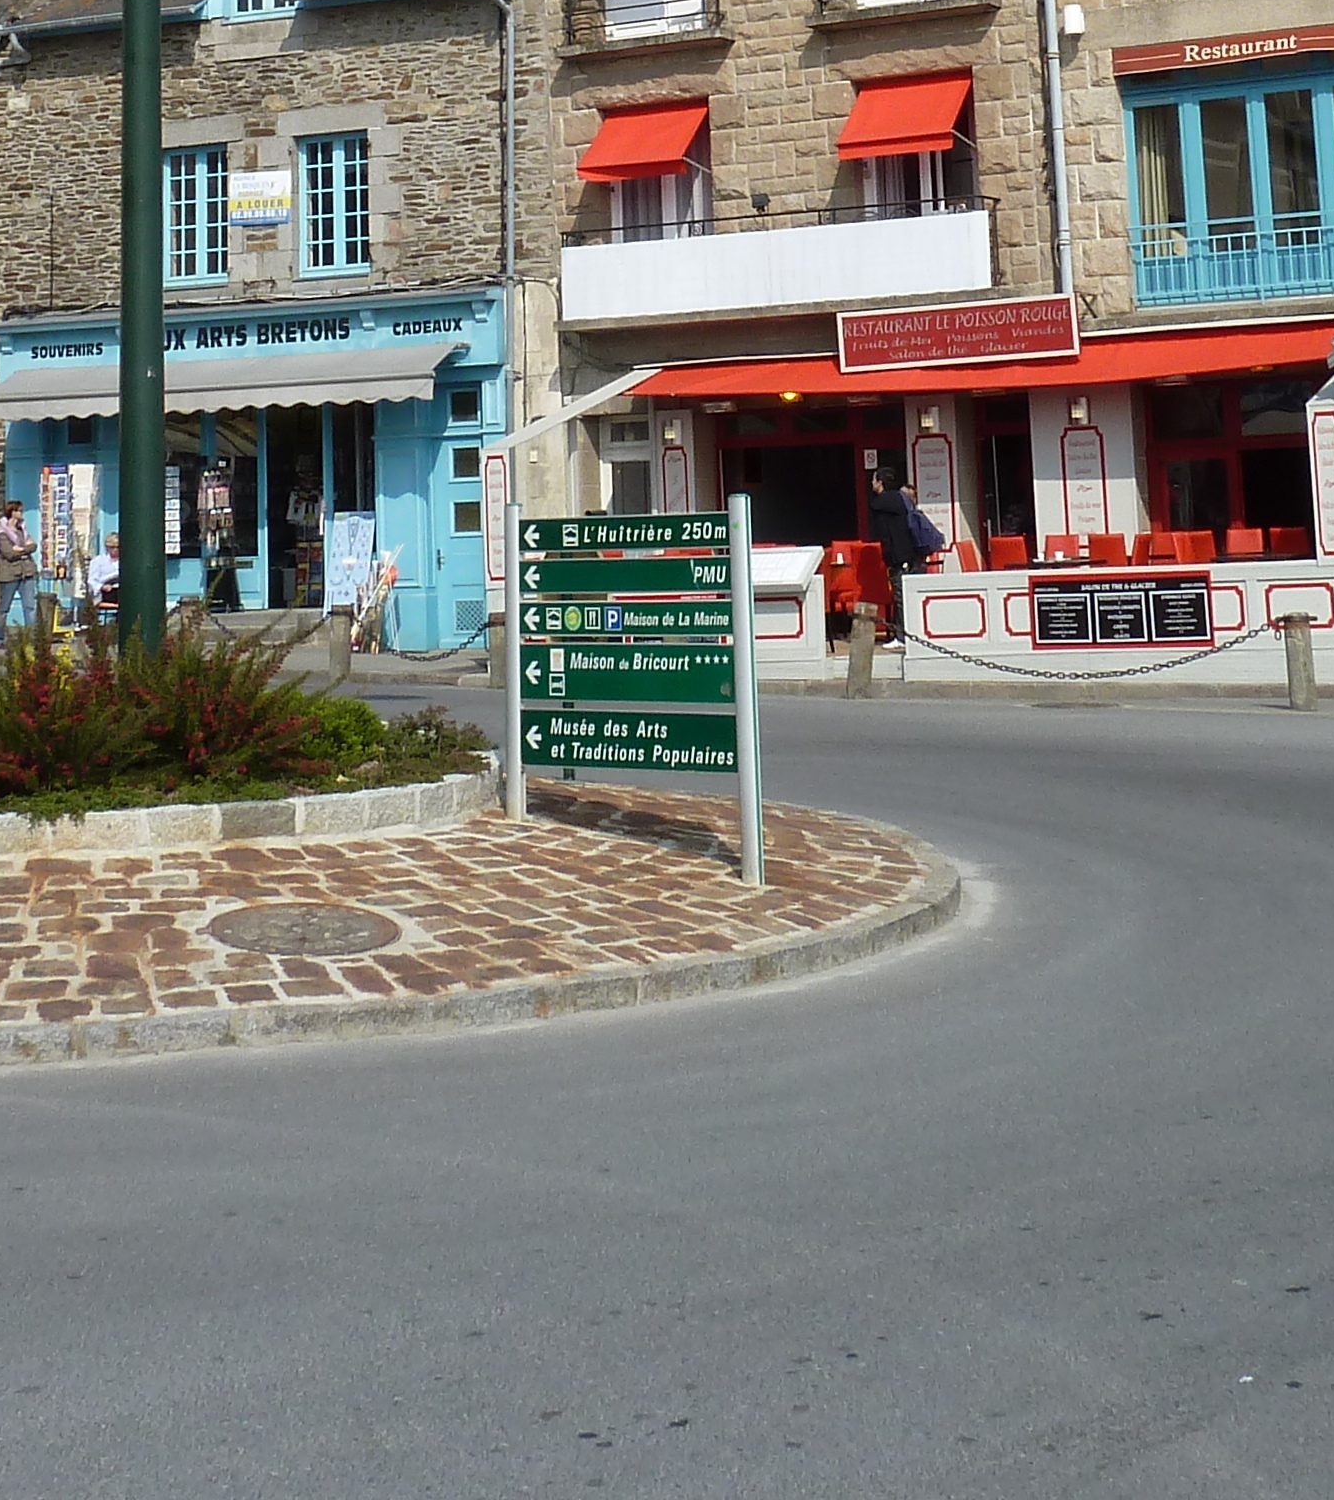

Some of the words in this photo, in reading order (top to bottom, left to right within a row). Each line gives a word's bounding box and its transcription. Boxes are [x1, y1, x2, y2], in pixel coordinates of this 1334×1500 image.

[1184, 35, 1297, 62] Restaurant
[237, 201, 243, 209] A
[248, 200, 284, 209] LOUER
[844, 315, 932, 338] RESTAURANT
[936, 315, 950, 330] LE
[955, 308, 1016, 329] POISSON
[1020, 304, 1069, 323] ROUGE
[30, 342, 103, 359] SOUVENIRS
[164, 328, 186, 352] UX
[195, 324, 248, 349] ARTS
[256, 318, 351, 345] BRETONS
[393, 317, 463, 336] CADEAUX
[892, 337, 907, 347] de
[947, 331, 999, 343] Poissons
[1012, 324, 1064, 337] Viandes
[928, 346, 943, 357] de
[583, 524, 672, 544] L'Huîtrière
[681, 522, 727, 540] 250m
[693, 565, 727, 584] PMU
[607, 610, 618, 627] P
[623, 611, 659, 626] Maison
[662, 612, 675, 626] de
[678, 612, 690, 626] La
[694, 611, 729, 626] Marine
[570, 652, 615, 670] Maison
[619, 658, 630, 670] de
[632, 652, 690, 671] Bricourt
[550, 717, 595, 736] Musée
[603, 719, 628, 737] des
[636, 720, 668, 739] Arts
[550, 743, 565, 759] et
[571, 742, 645, 762] Traditions
[653, 744, 735, 767] Populaires
